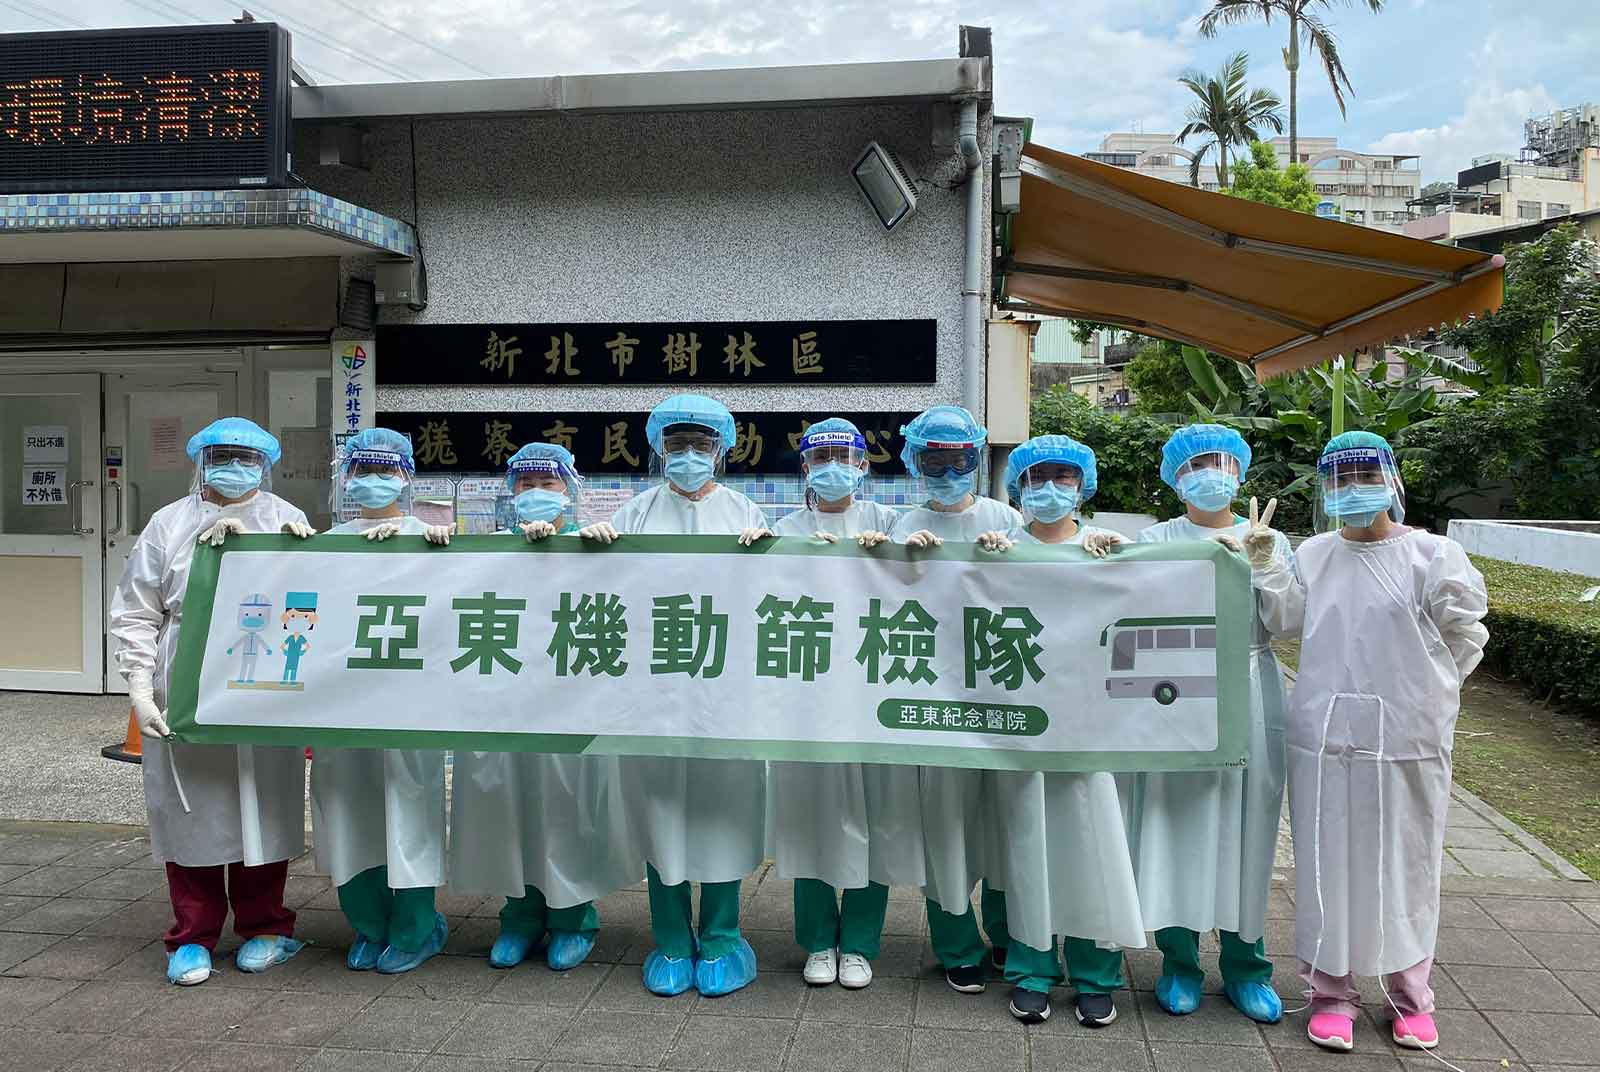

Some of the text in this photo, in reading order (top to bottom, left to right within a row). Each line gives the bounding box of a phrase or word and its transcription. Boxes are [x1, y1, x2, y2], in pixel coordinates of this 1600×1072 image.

[479, 330, 825, 379] 新北市樹林區
[345, 381, 362, 434] 新北市
[26, 487, 63, 503] 不外借
[346, 591, 1047, 691] 亞東機動篩檢隊
[898, 704, 1028, 732] 亞東紀念醫院
